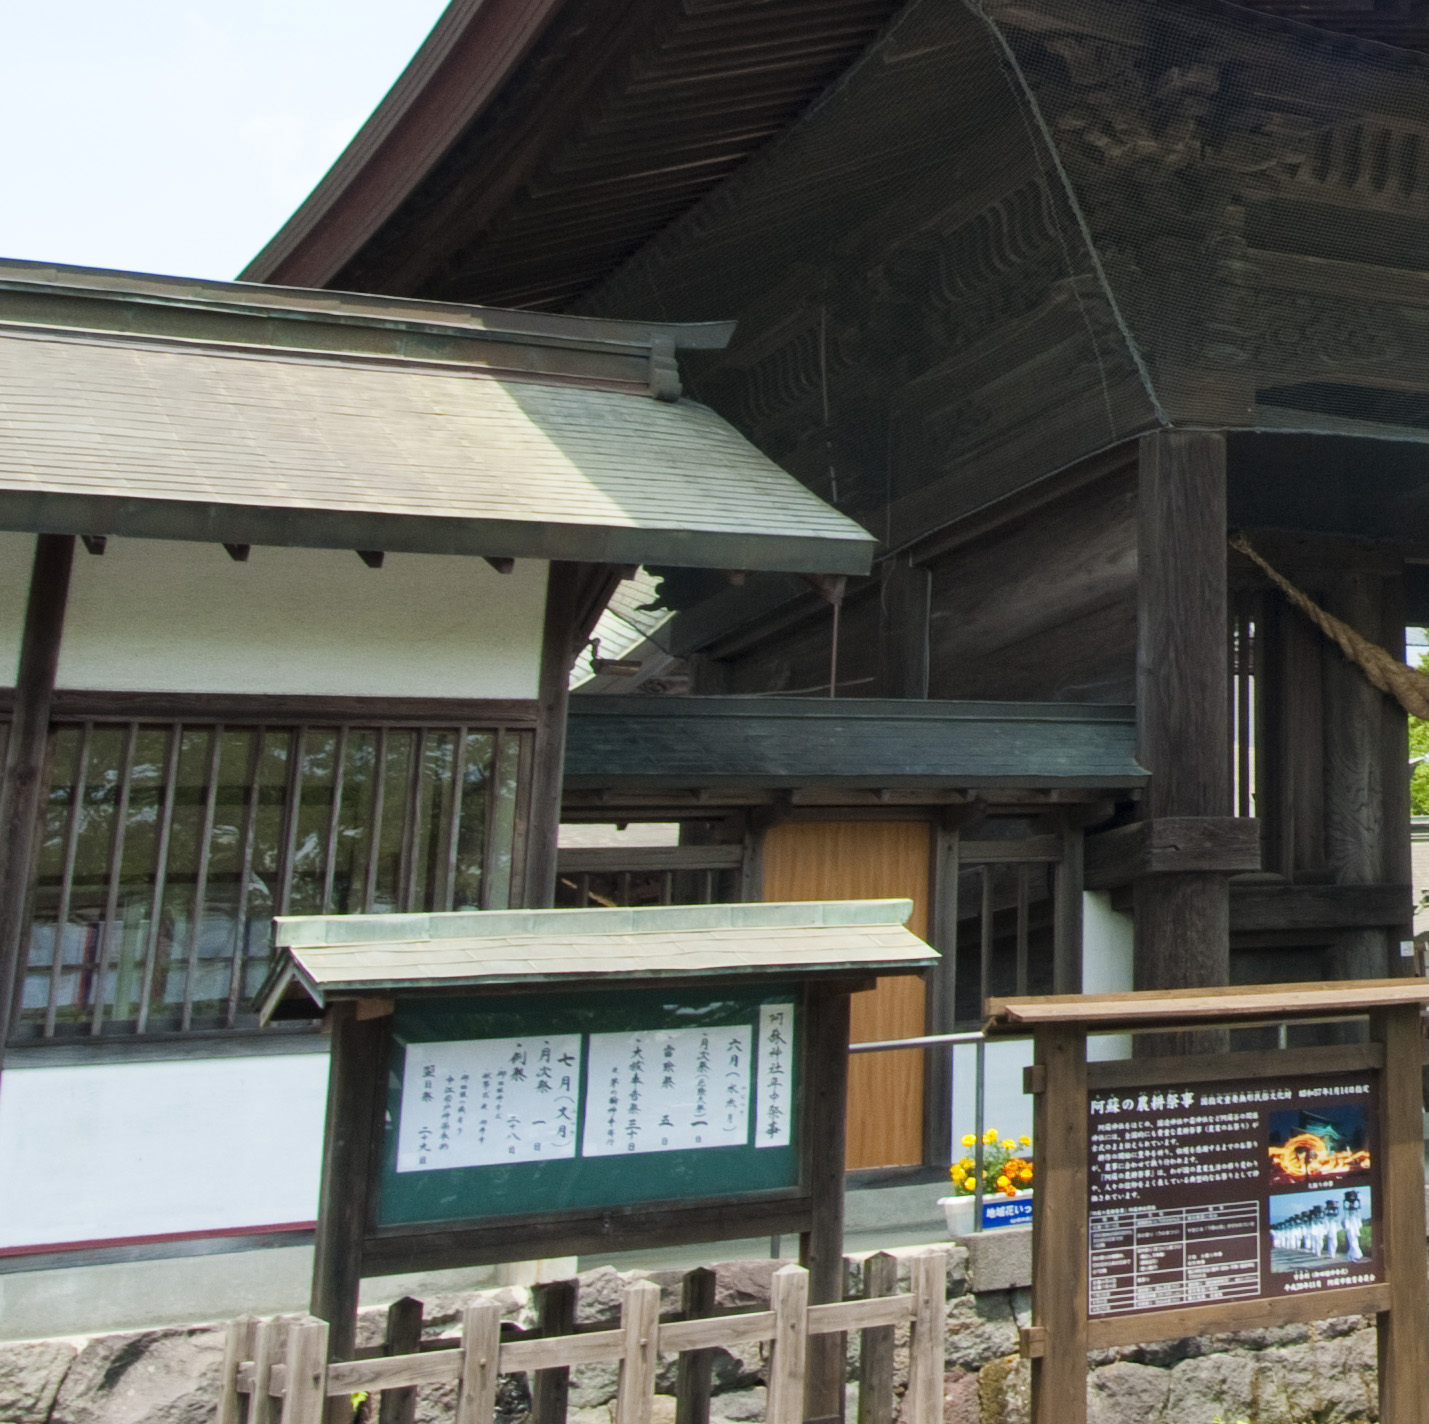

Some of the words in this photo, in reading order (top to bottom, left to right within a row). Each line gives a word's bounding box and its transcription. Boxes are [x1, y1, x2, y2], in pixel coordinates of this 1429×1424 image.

[765, 1012, 787, 1139] 阿蘇神社年中祭事
[1090, 1091, 1195, 1115] 阿蘇の農耕祭事
